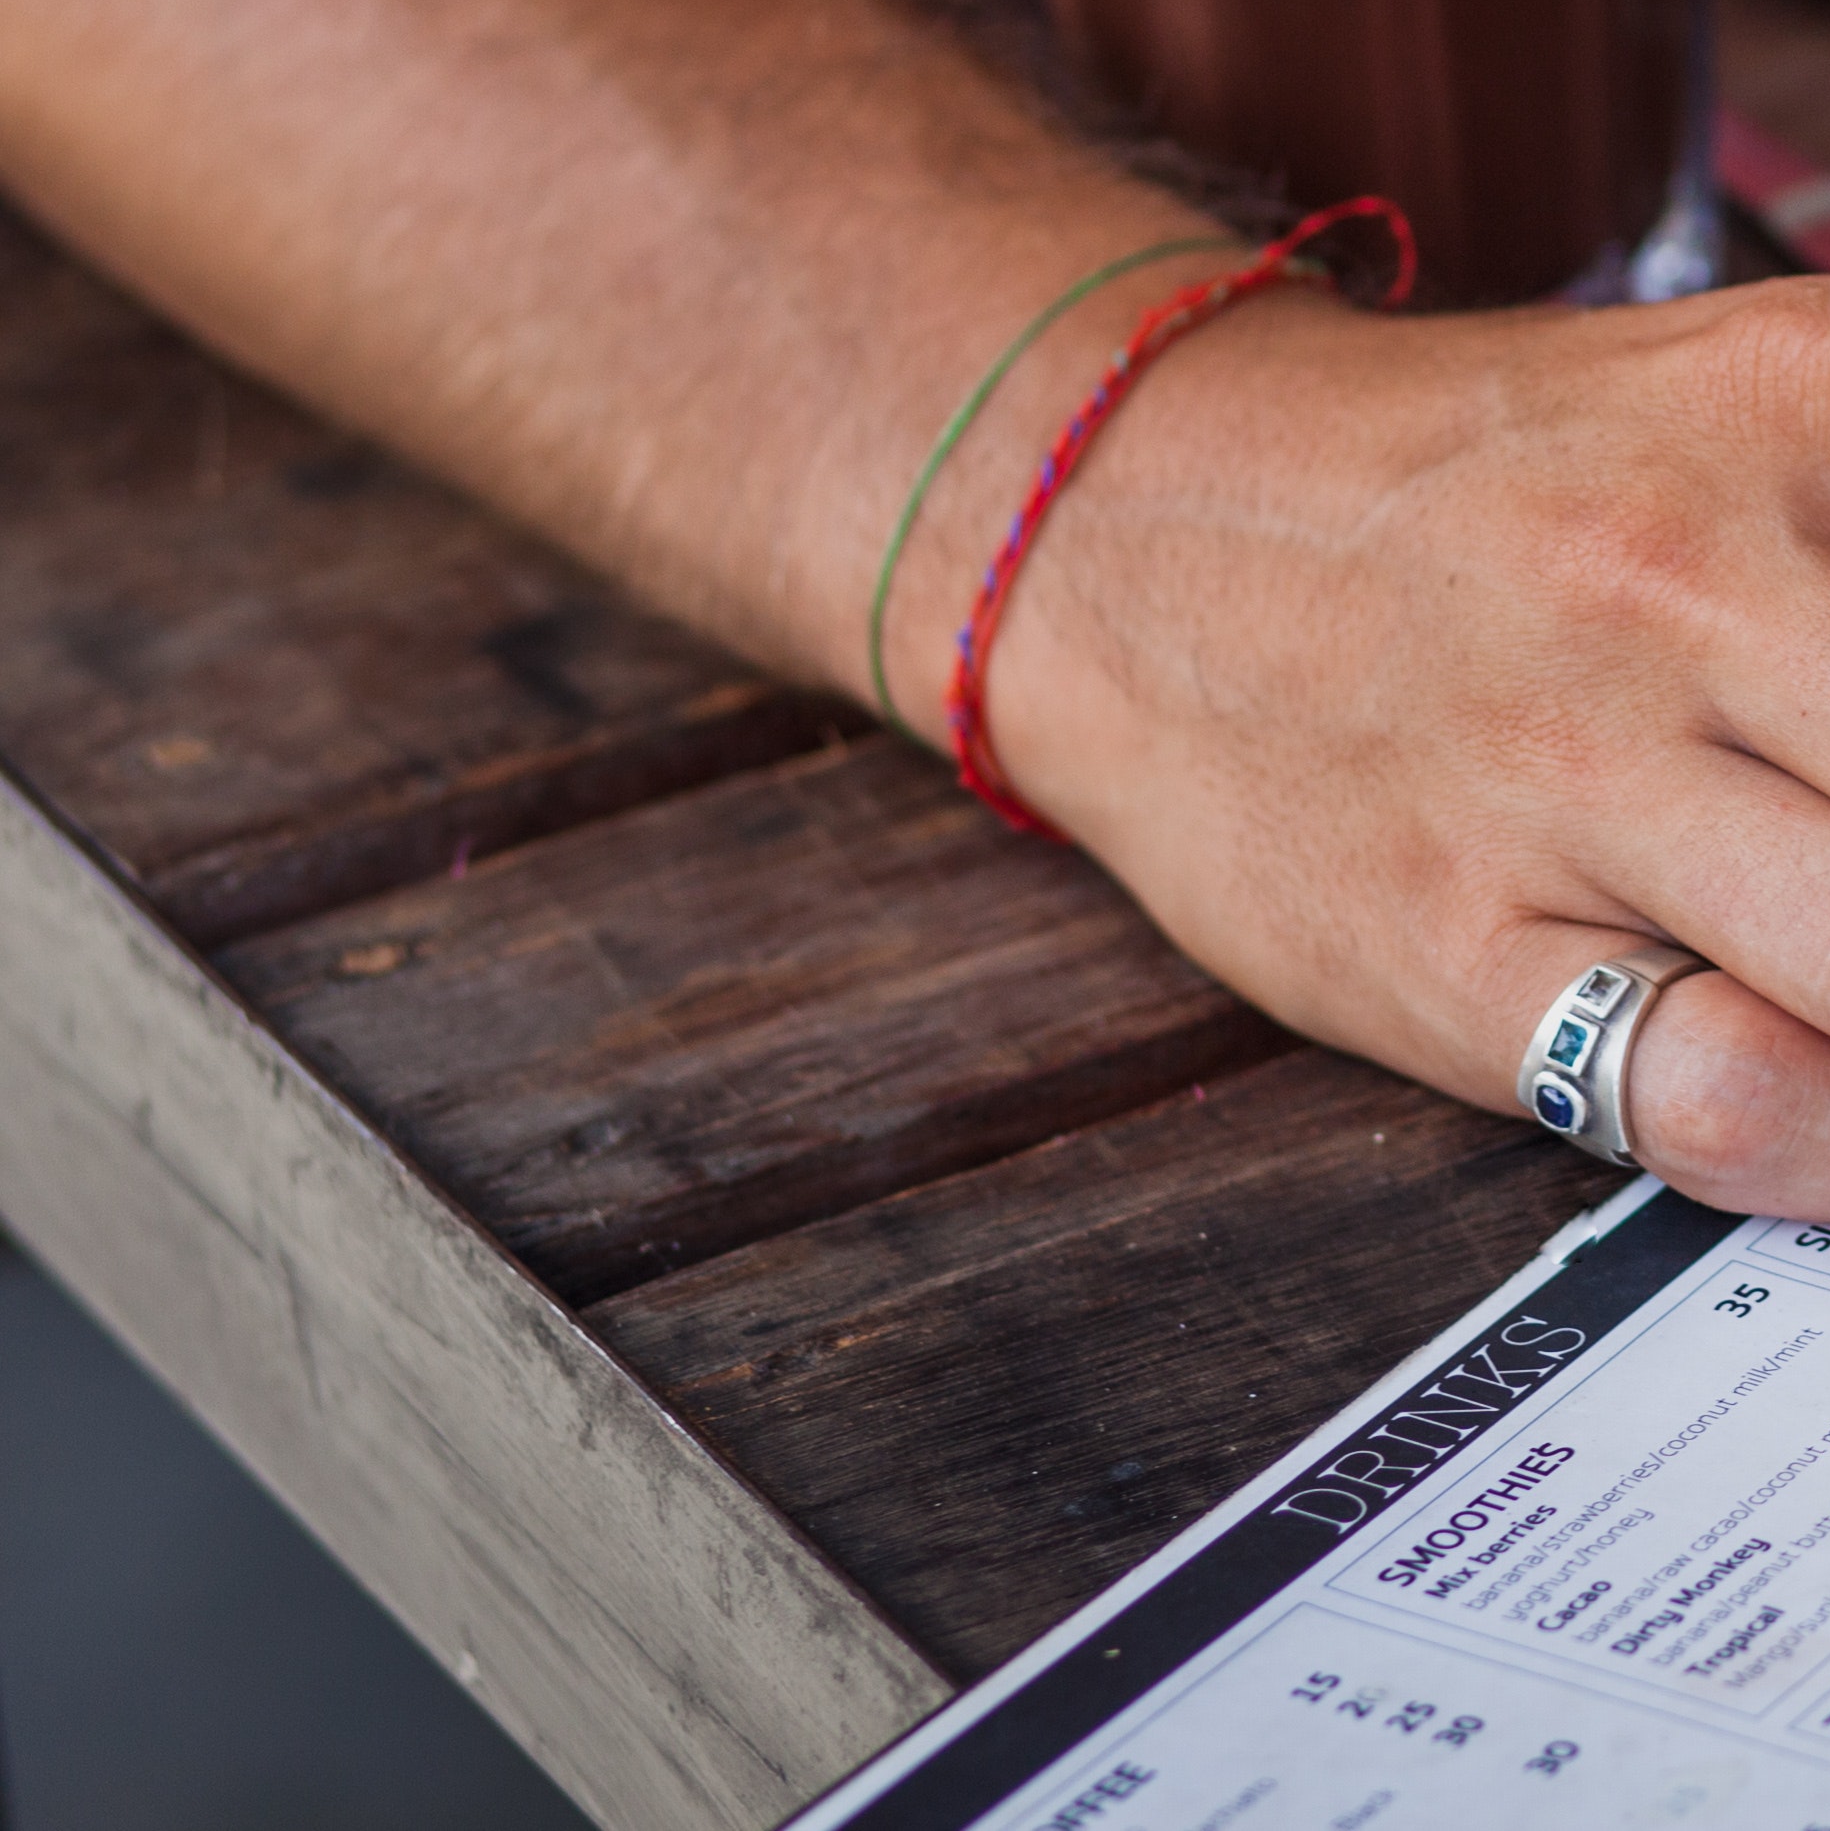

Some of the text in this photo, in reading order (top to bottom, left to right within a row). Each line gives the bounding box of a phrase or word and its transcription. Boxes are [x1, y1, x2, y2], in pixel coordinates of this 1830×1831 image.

[1713, 1282, 1771, 1319] 35
[1271, 1315, 1588, 1536] DRINKS
[1461, 1326, 1824, 1612] banana/strawberries/coconut milk/mint
[1377, 1442, 1577, 1588] SMOOTHIES
[1424, 1503, 1558, 1600] Mix berries
[1571, 1552, 1694, 1644] banana/raw
[1690, 1445, 1827, 1554] cacao/coconut
[1501, 1507, 1656, 1623] yoghurt/honey
[1535, 1579, 1613, 1633] Cacao
[1609, 1536, 1774, 1657] Dirty Monkey
[1649, 1549, 1801, 1668] banana/peanut
[1289, 1671, 1342, 1704] 15
[1683, 1604, 1787, 1678] Tropical
[1385, 1699, 1438, 1735] 25
[1431, 1715, 1485, 1749] 30
[1521, 1739, 1581, 1779] 30
